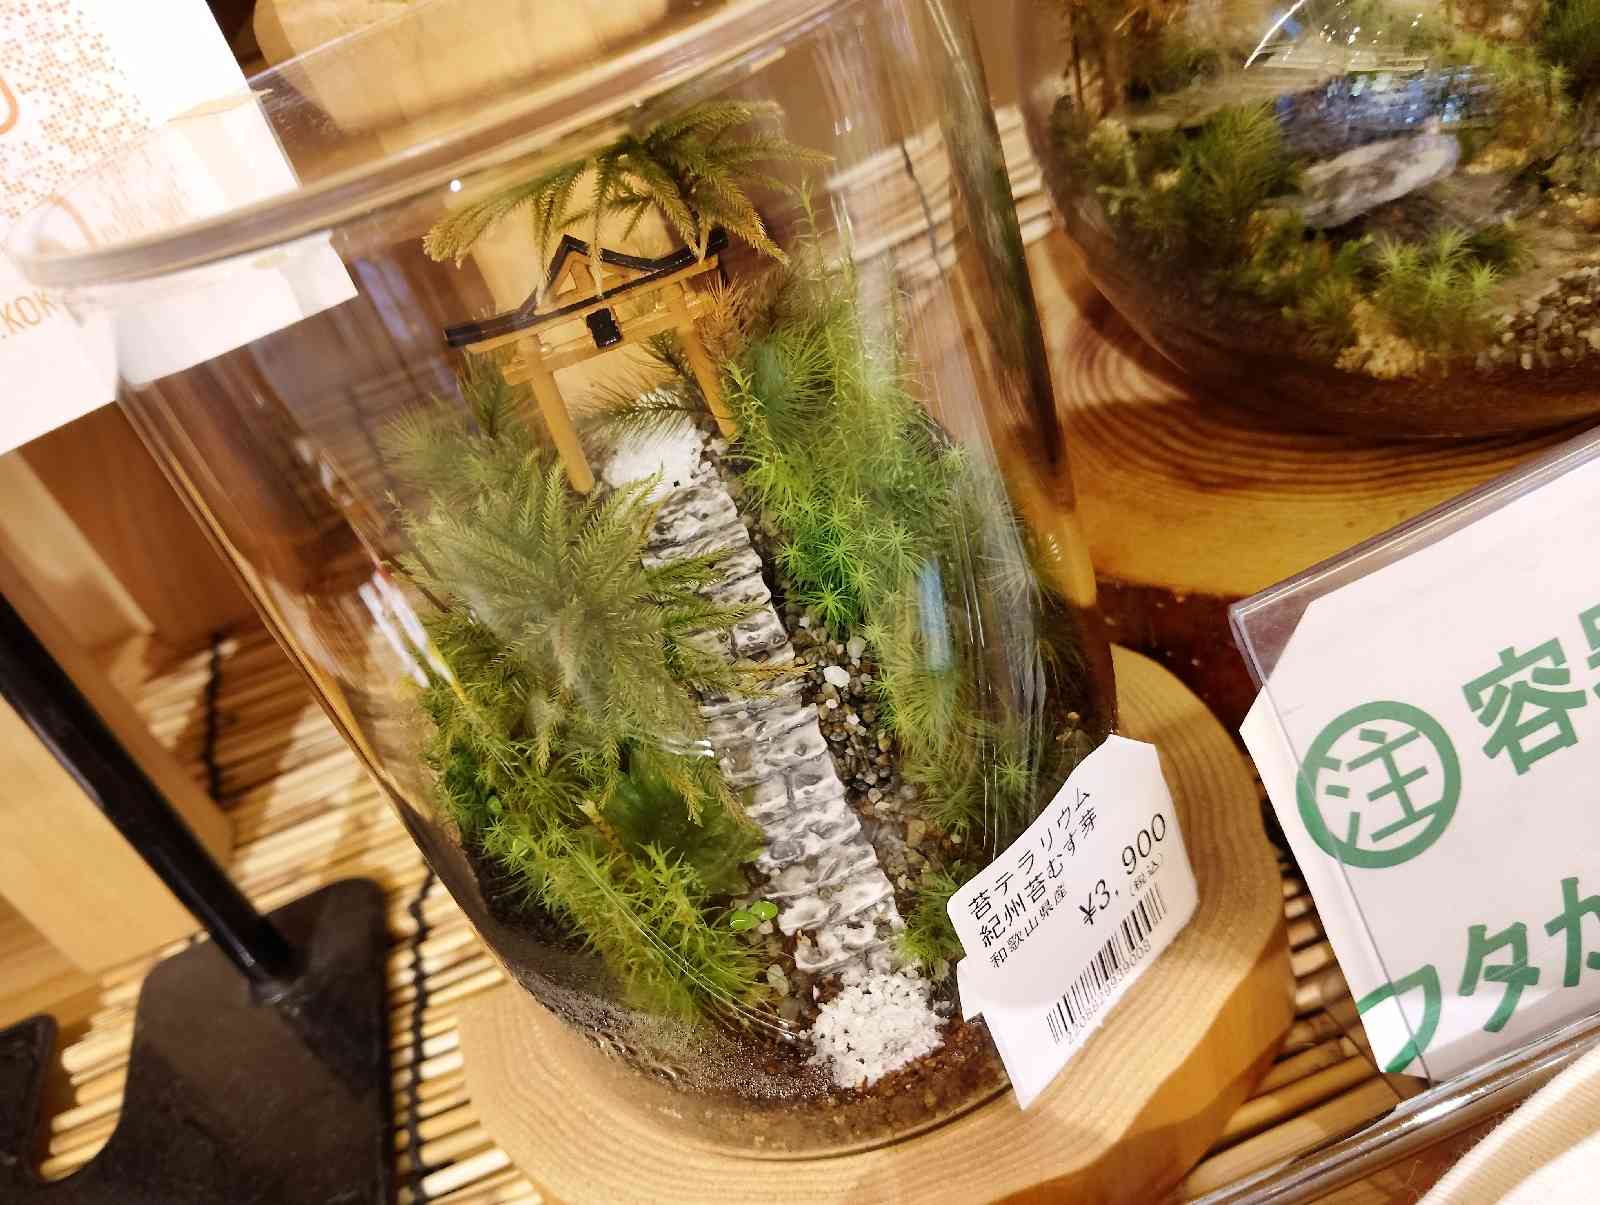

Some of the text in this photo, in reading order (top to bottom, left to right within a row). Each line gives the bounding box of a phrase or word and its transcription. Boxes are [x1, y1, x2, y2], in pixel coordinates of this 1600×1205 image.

[1462, 604, 1600, 776] 容
[968, 787, 1091, 920] 苔テラリウム
[980, 808, 1096, 948] 紀州苔むす芽
[990, 884, 1068, 968] 和歌山県産
